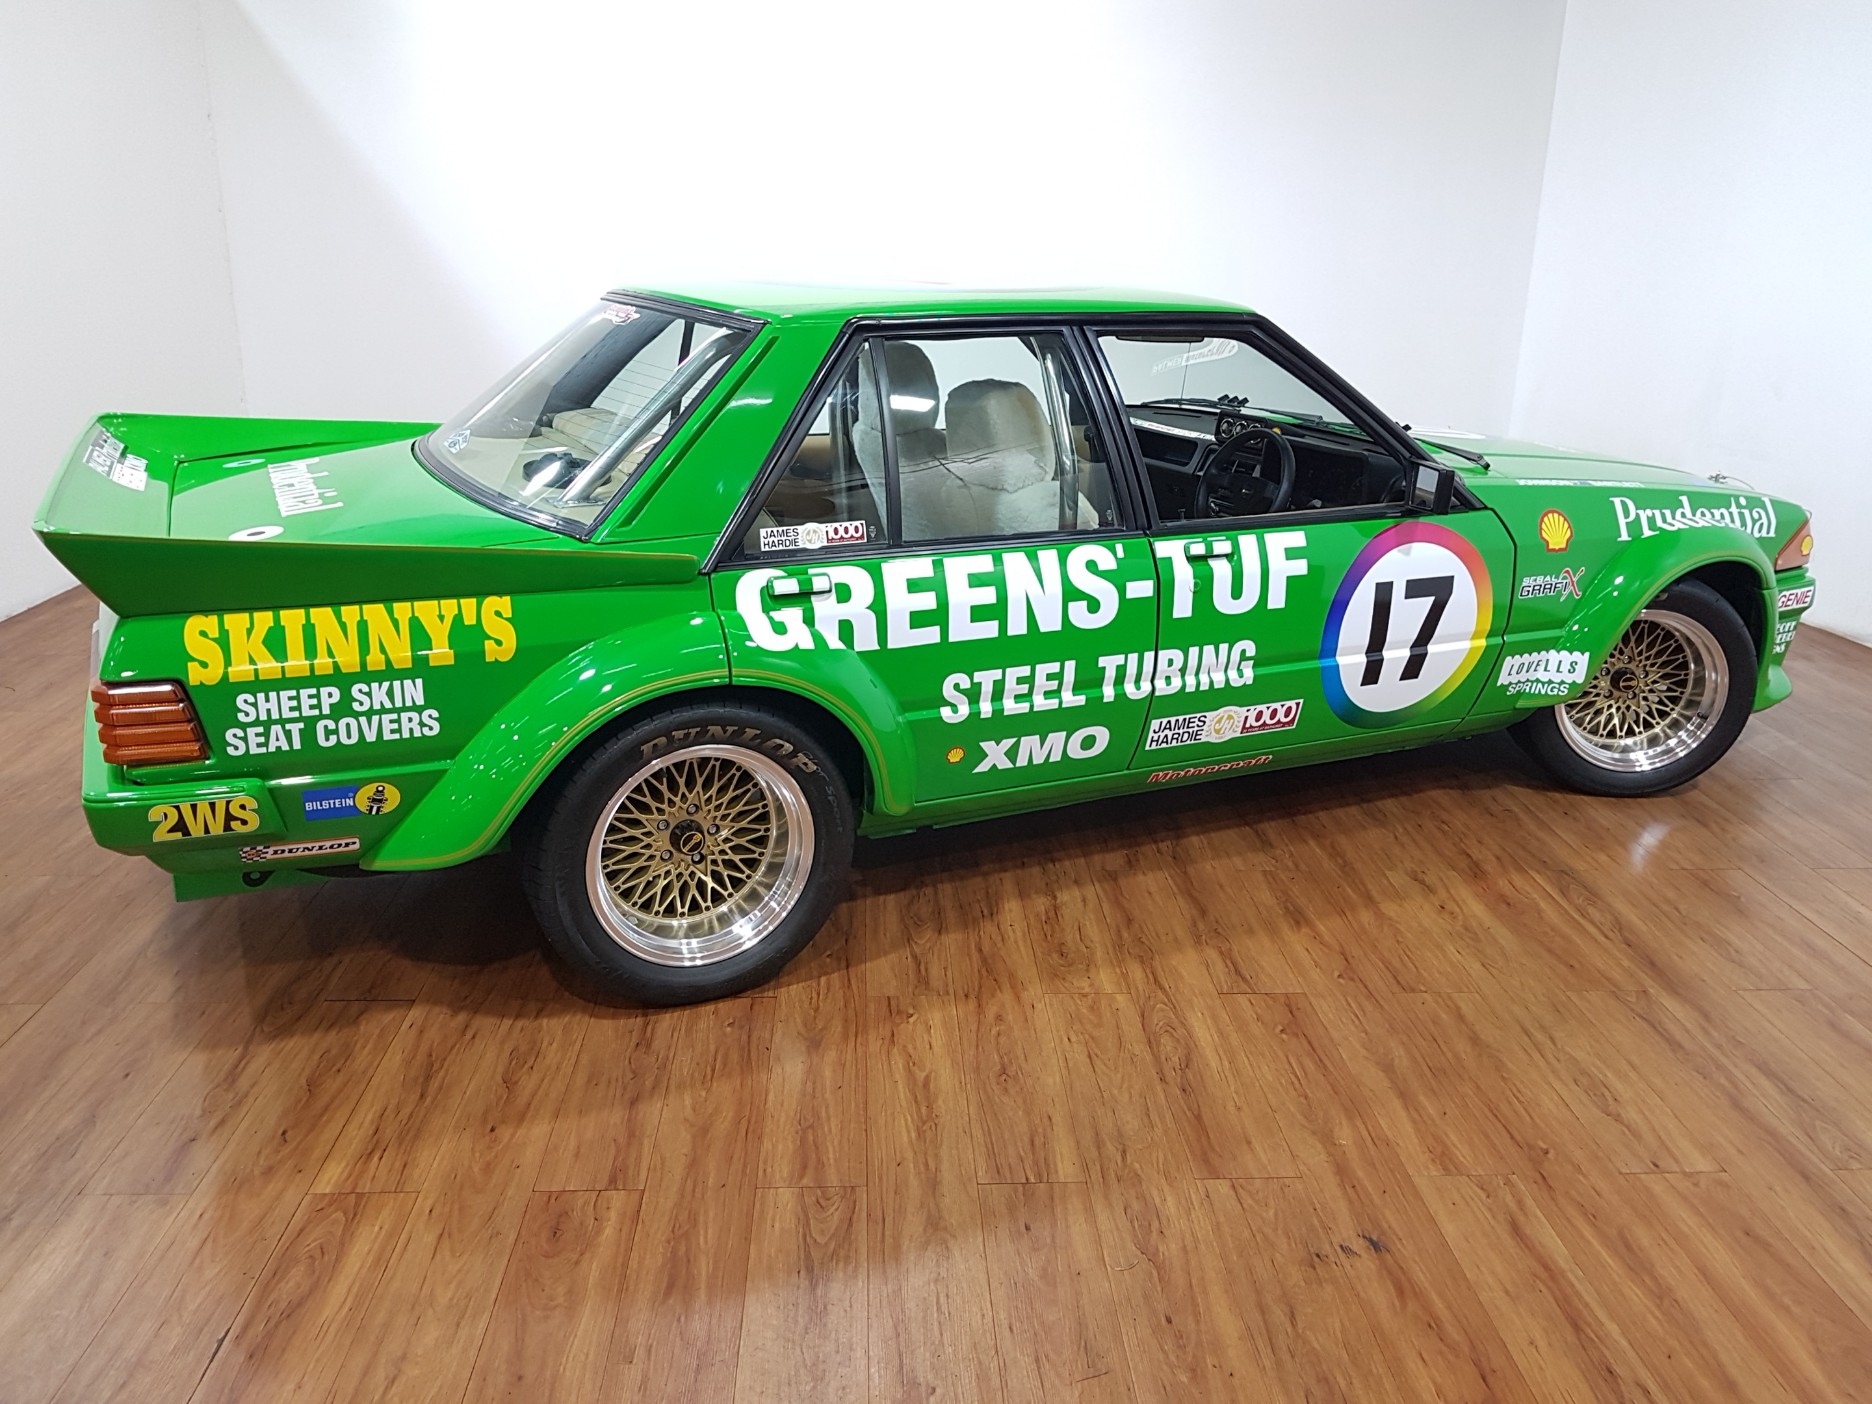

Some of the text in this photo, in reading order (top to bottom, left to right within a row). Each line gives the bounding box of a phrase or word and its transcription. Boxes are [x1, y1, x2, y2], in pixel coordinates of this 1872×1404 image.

[825, 522, 863, 540] 1000
[1609, 495, 1777, 541] Prudential
[762, 527, 799, 540] JAMES
[763, 538, 800, 550] HARDIE
[1518, 566, 1585, 602] GRAFIX
[1778, 589, 1812, 609] GENIE
[183, 595, 517, 686] SKINNY'S
[1360, 575, 1455, 687] 17
[1507, 658, 1578, 677] LOVELLS
[939, 639, 1256, 724] STEEL TUBING
[1506, 681, 1570, 696] SPRINGS
[235, 678, 425, 723] SHEEP SKIN
[1153, 714, 1207, 735] JAMES
[1244, 703, 1298, 728] 1000
[225, 709, 441, 757] SEAT COVERS
[1149, 728, 1204, 748] HARDIE
[640, 725, 818, 773] DUNLOP
[972, 725, 1110, 774] XMO
[1147, 755, 1273, 783] Motorcraft
[304, 797, 354, 811] BILSTEIN
[148, 795, 260, 842] 2WS
[270, 841, 358, 856] DUNLOP
